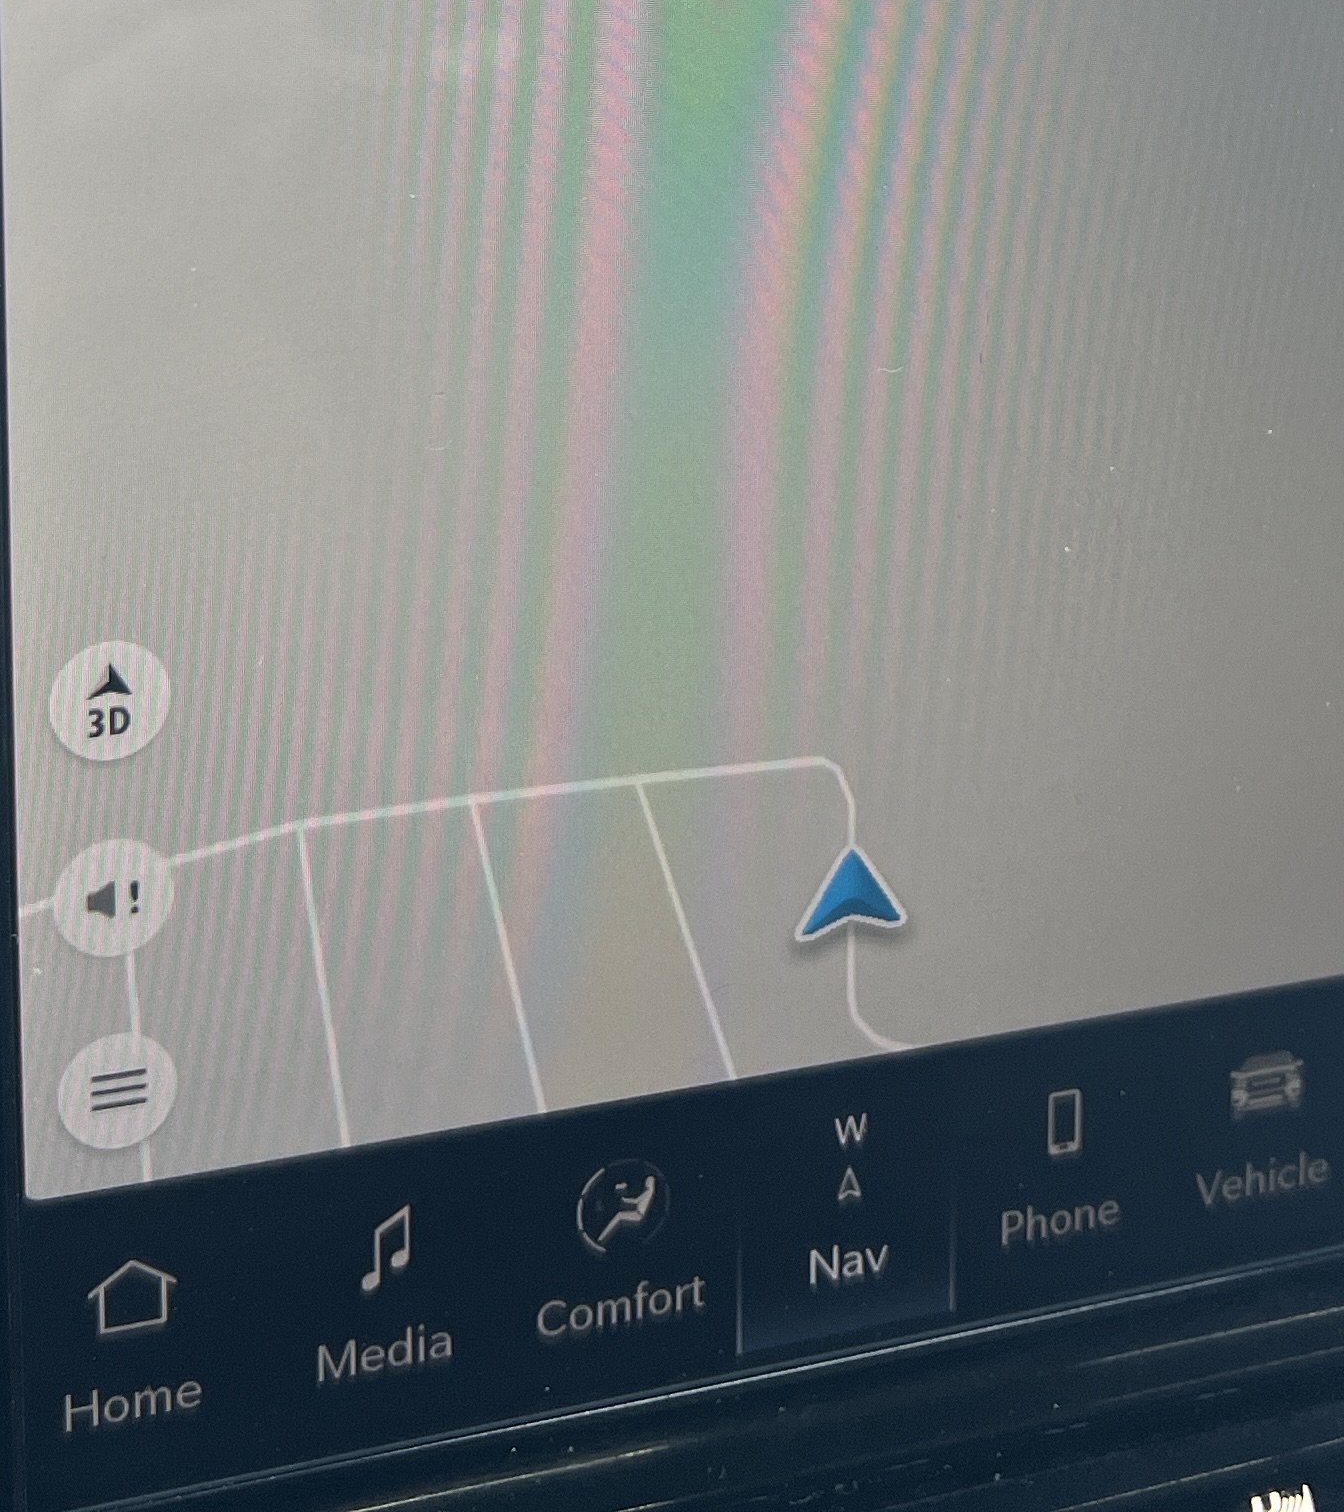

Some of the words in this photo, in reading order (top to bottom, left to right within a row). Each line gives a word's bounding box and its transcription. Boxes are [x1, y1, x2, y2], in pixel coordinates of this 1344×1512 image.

[87, 705, 131, 738] 3D
[834, 1111, 869, 1146] W
[1195, 1148, 1332, 1209] Vehicle
[1000, 1196, 1121, 1246] Phone
[809, 1242, 890, 1286] Nav
[536, 1274, 707, 1339] Comfort
[316, 1323, 454, 1383] Media
[62, 1375, 204, 1433] Home
